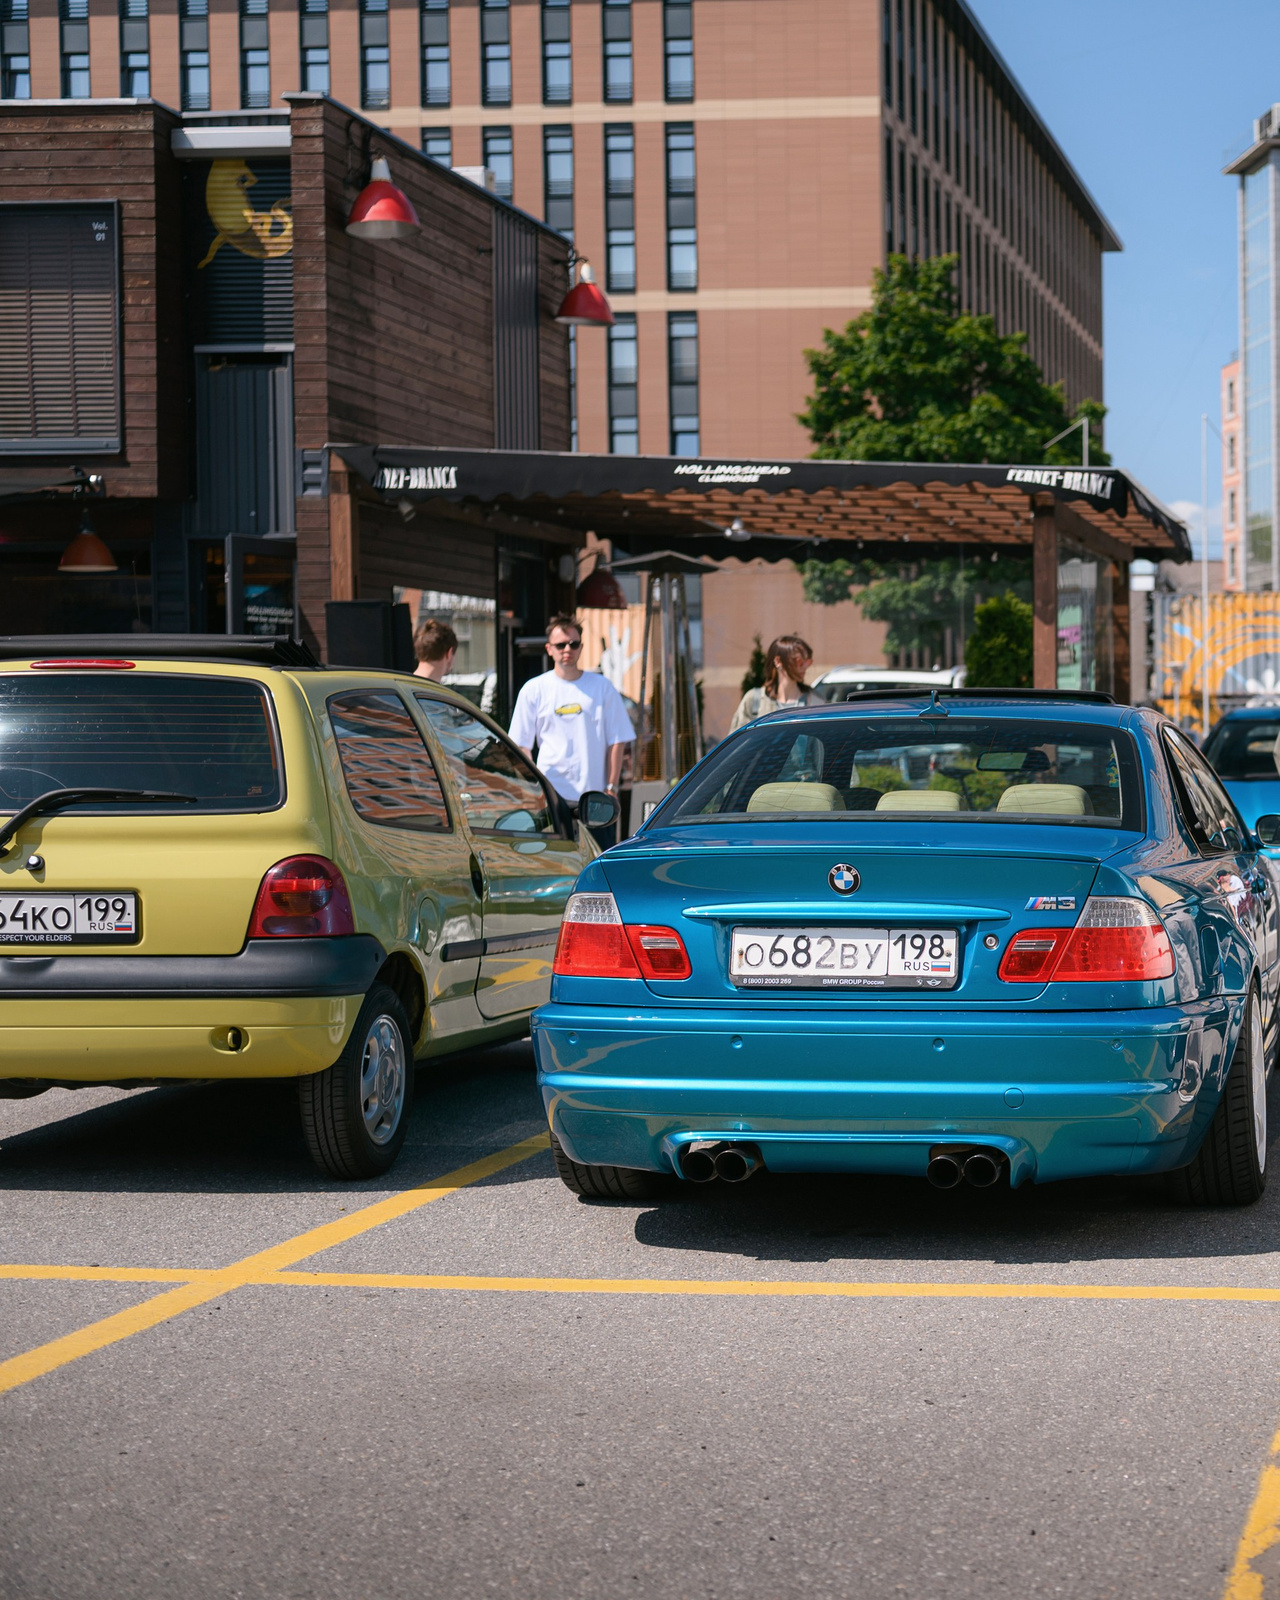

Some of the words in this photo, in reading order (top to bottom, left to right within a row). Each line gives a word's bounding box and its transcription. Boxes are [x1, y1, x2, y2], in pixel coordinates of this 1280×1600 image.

[91, 221, 108, 231] Vol.
[674, 464, 792, 476] HOLLINGSHEAD
[1006, 468, 1116, 500] FERNET-BRANCA
[830, 864, 858, 876] BMW
[79, 897, 127, 921] 199
[89, 922, 114, 931] RUS
[25, 934, 45, 942] YOUR
[45, 934, 73, 942] ELDERS
[892, 933, 945, 960] 198
[903, 961, 930, 971] RUS
[748, 977, 764, 985] (800)
